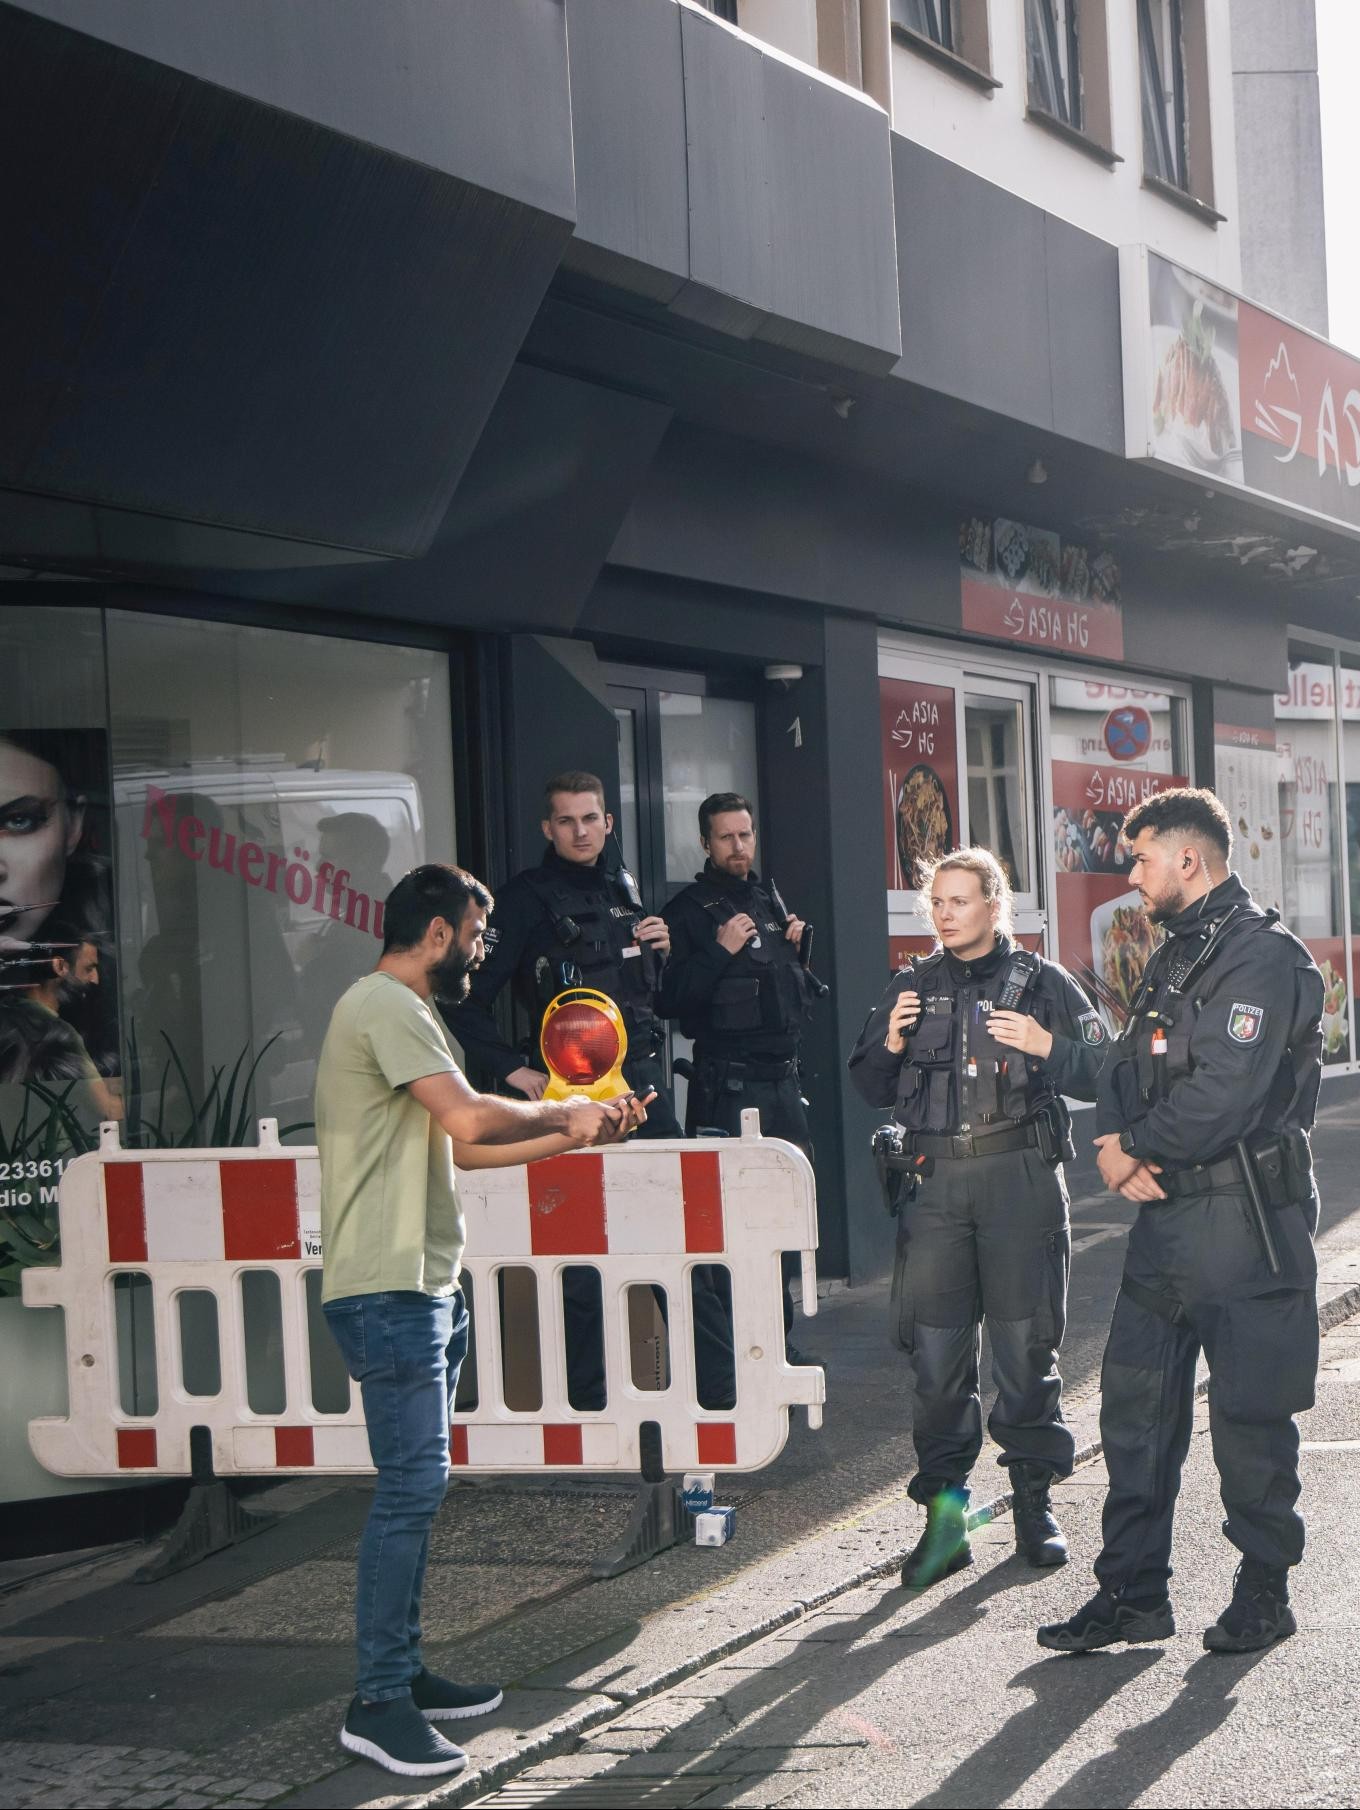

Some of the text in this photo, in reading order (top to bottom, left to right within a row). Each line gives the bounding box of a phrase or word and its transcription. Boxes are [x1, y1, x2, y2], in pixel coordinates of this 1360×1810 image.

[1028, 606, 1089, 648] ASIA HG
[912, 701, 939, 726] ASIA
[786, 715, 803, 748] 1
[918, 732, 935, 755] HG
[1107, 776, 1137, 808] ASIA
[1296, 755, 1328, 796] ASIA
[1302, 808, 1323, 849] HG
